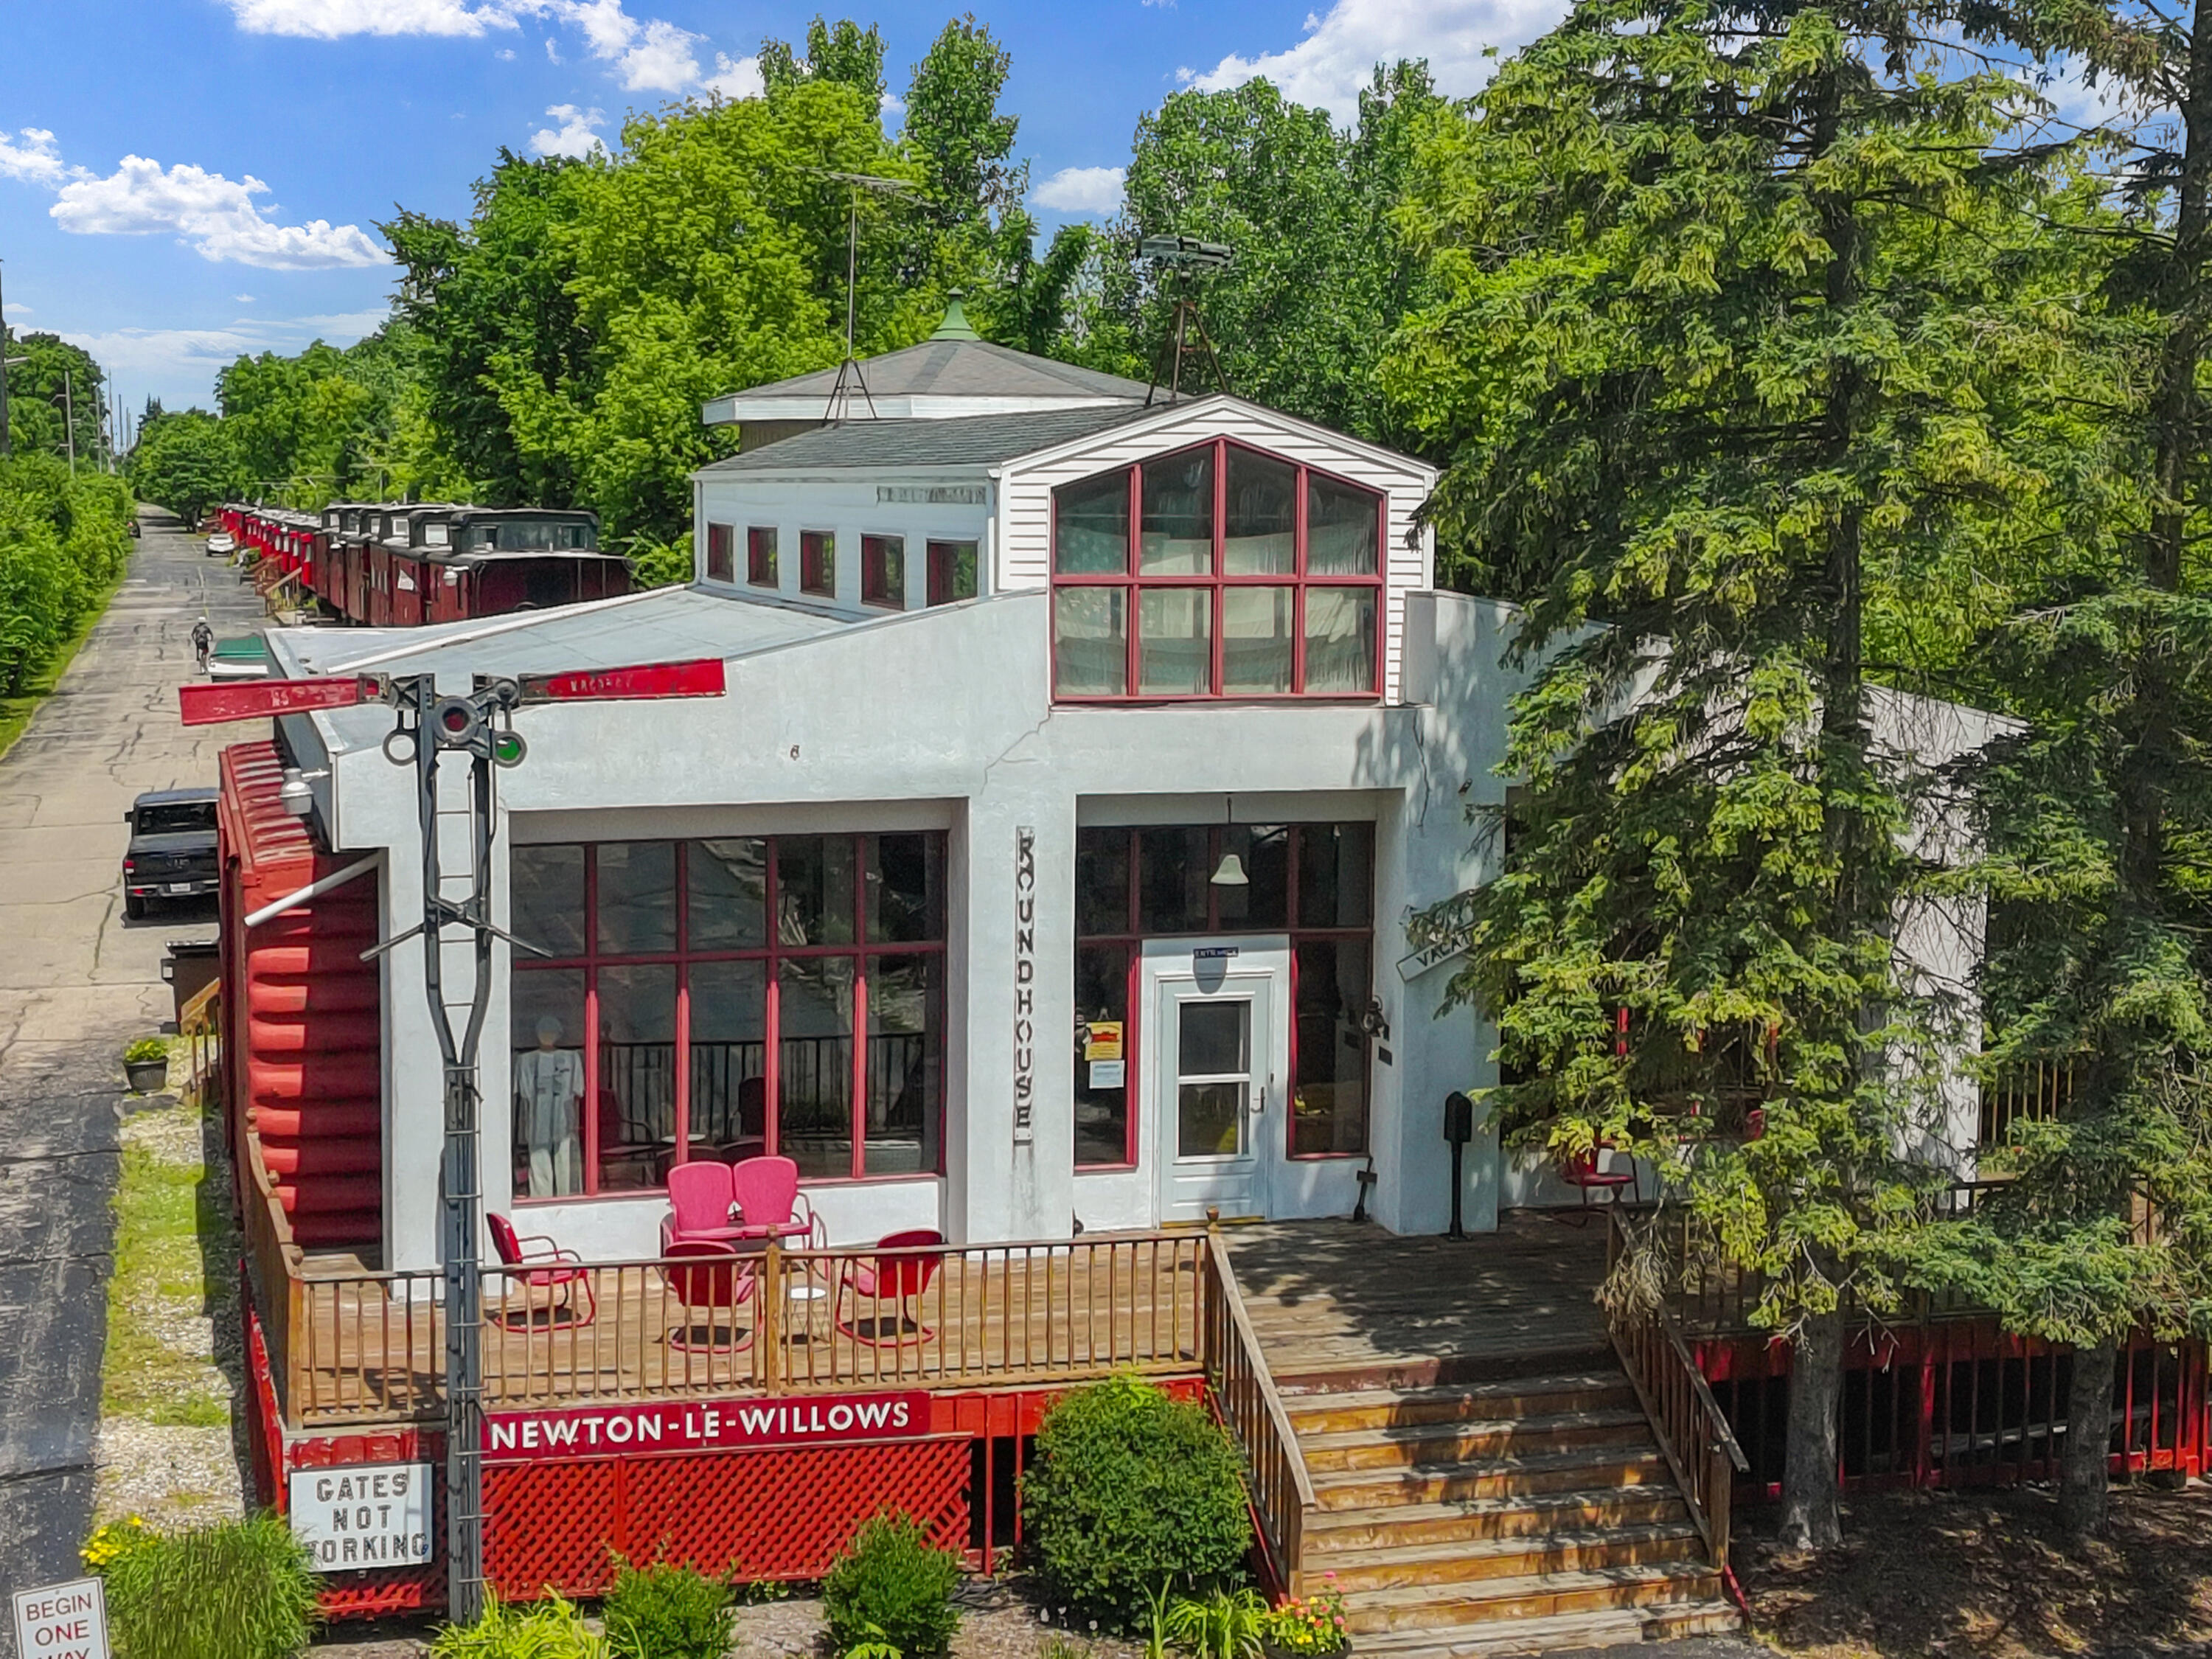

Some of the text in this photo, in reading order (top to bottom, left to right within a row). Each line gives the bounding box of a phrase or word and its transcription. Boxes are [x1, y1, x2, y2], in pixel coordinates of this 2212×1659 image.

[1017, 836, 1034, 1128] ROUNDHOUSE
[492, 1401, 909, 1450] NEWTON-LE-WILLOWS
[316, 1472, 408, 1502] GATES
[333, 1504, 392, 1531] NOT
[26, 1593, 92, 1621] BEGIN
[35, 1619, 90, 1646] ONE
